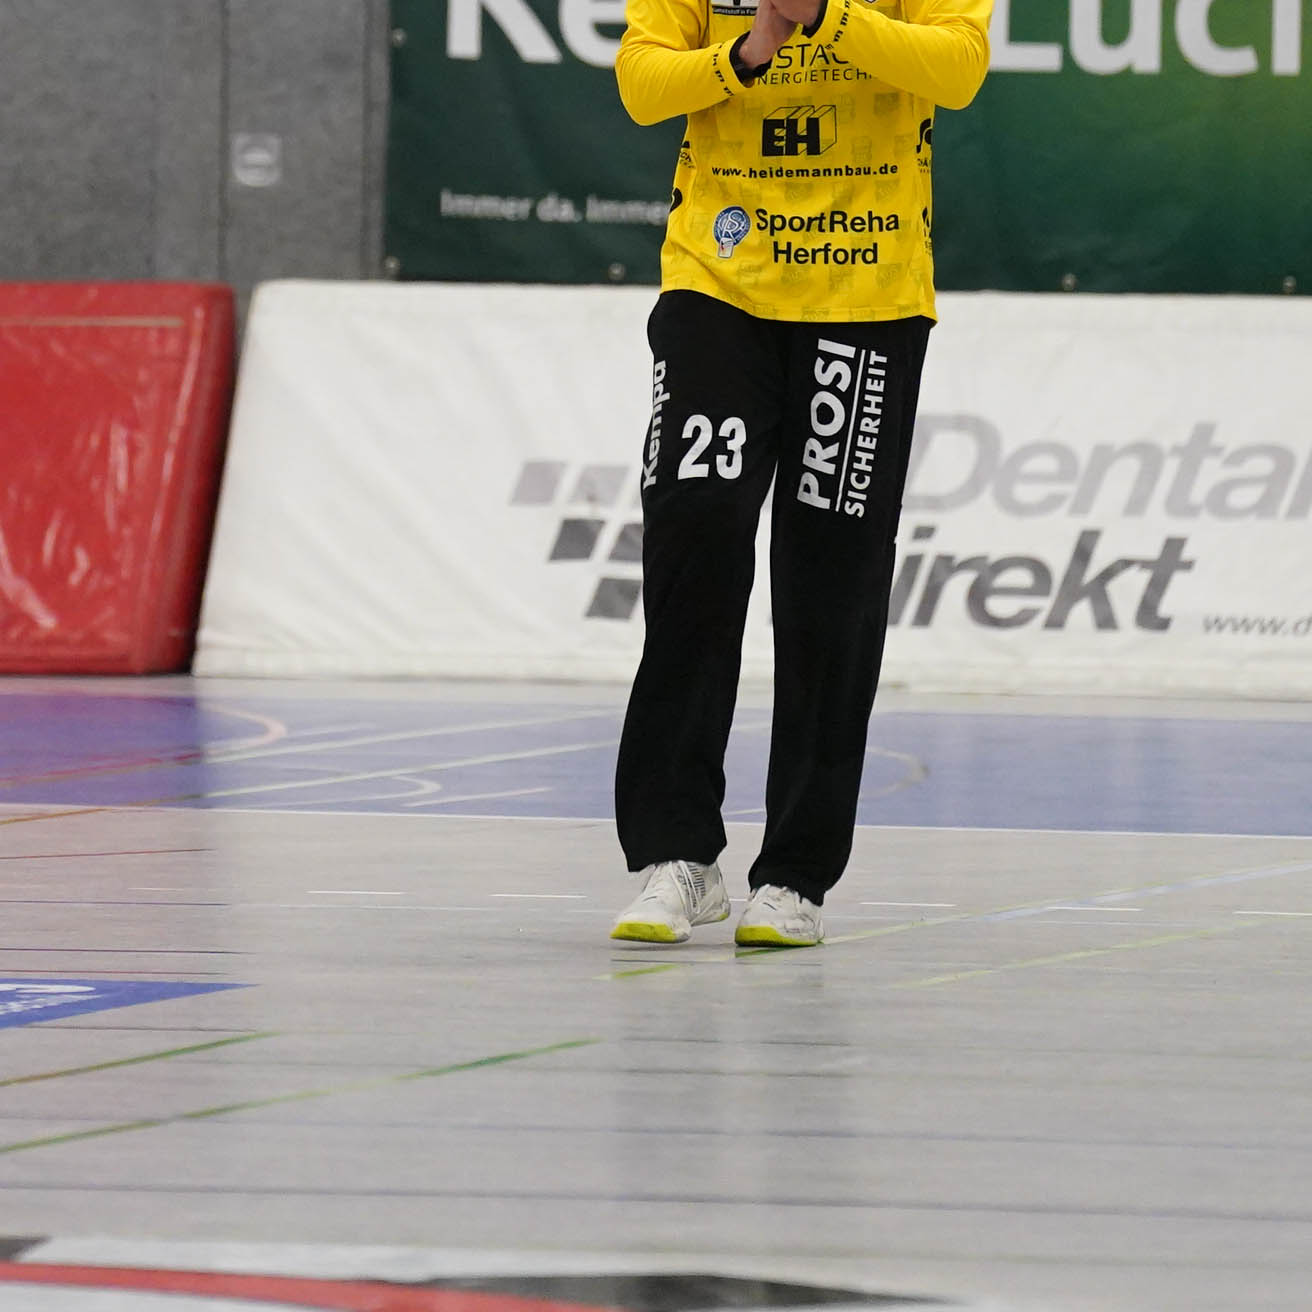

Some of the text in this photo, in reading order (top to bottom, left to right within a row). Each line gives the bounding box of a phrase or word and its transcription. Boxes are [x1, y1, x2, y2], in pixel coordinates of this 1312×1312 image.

[761, 118, 821, 158] EH
[711, 163, 899, 180] www.heidemannbau.de
[586, 195, 672, 226] Imme
[772, 241, 879, 266] Herford
[677, 413, 747, 481] 23
[796, 338, 857, 510] PROSI
[844, 350, 888, 518] SICHERHEIT
[887, 525, 1195, 632] irekt
